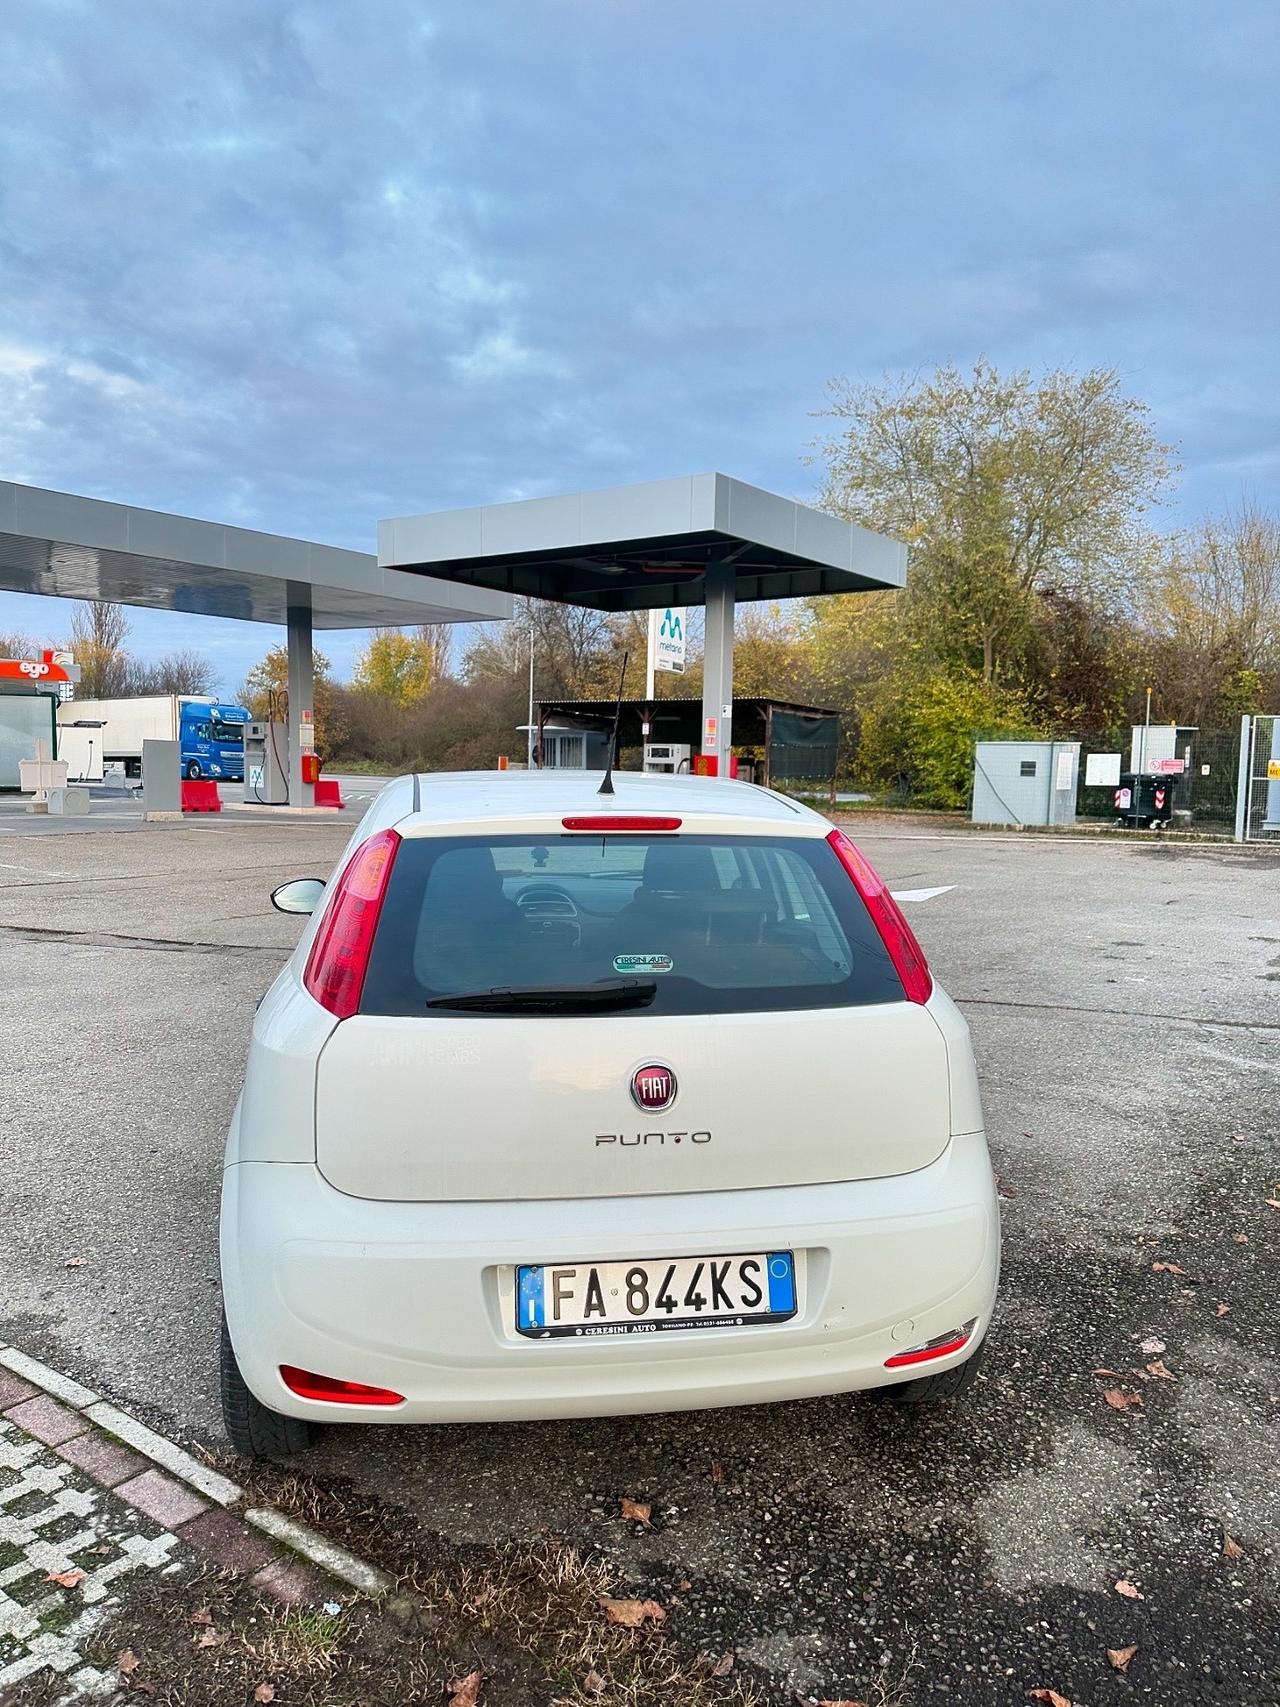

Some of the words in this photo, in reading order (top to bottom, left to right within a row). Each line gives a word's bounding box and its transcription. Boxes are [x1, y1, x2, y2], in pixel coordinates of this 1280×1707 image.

[659, 641, 683, 654] metano
[19, 662, 50, 678] ego
[647, 956, 671, 964] AUTO
[641, 1076, 669, 1099] FIAT
[595, 1130, 712, 1147] PUNTO
[553, 1267, 606, 1321] FA
[625, 1259, 763, 1316] 844KS
[585, 1325, 628, 1335] CERESINI
[632, 1324, 657, 1333] AUTO
